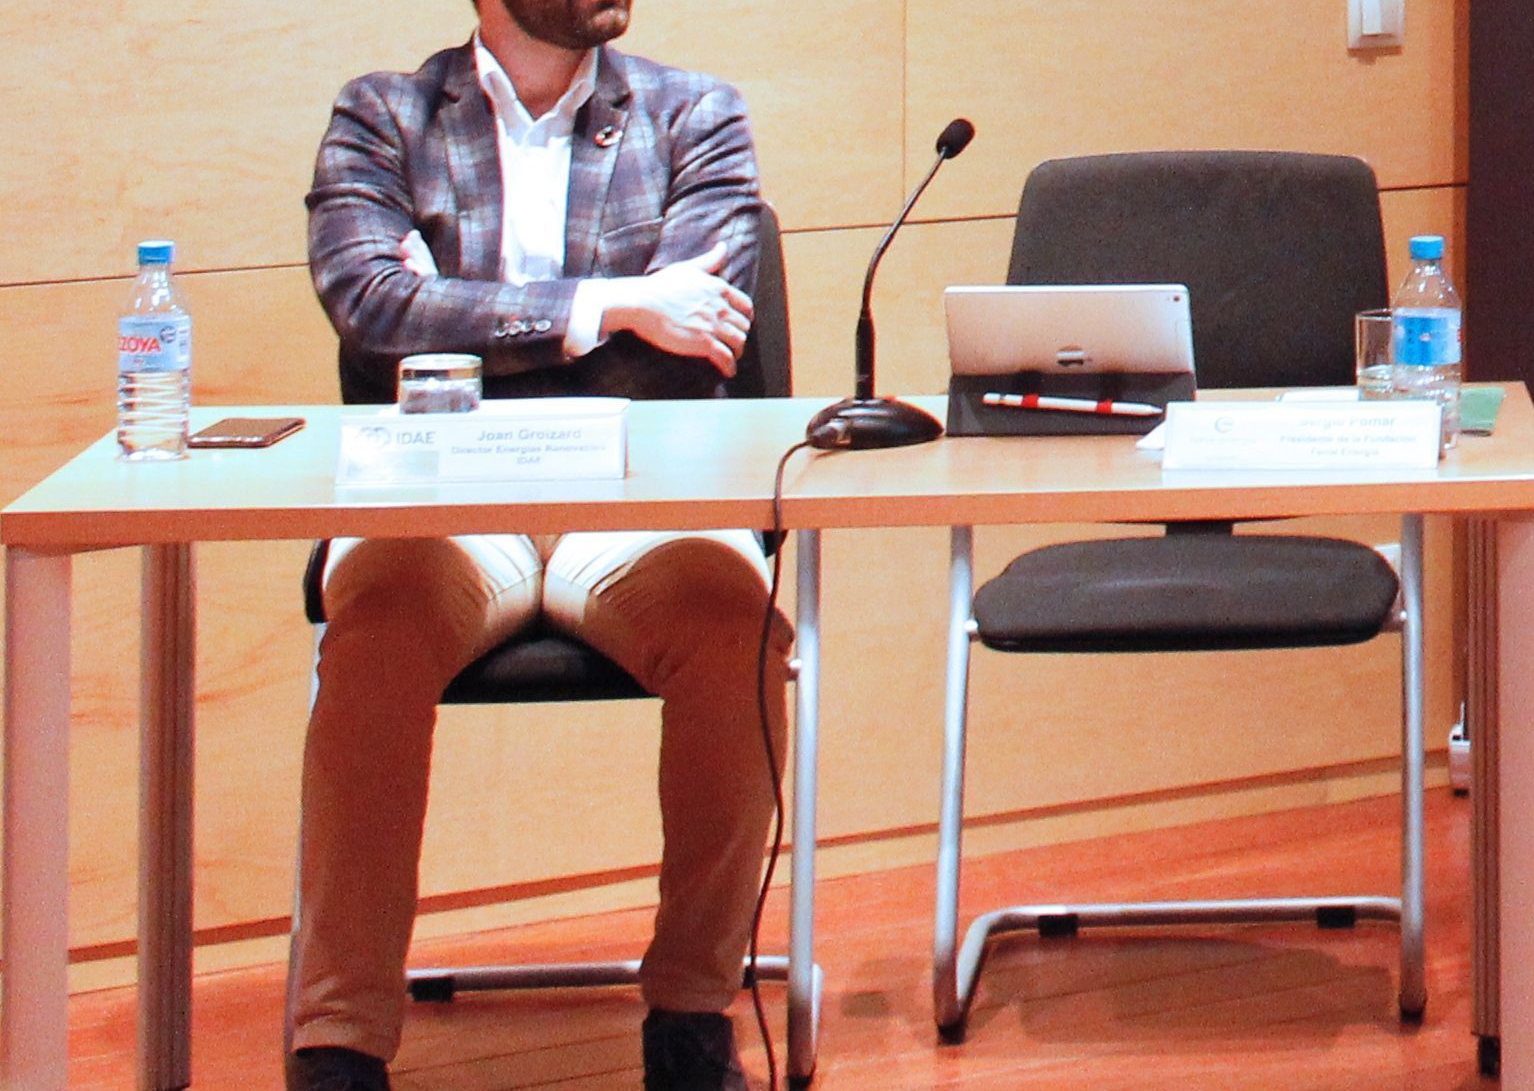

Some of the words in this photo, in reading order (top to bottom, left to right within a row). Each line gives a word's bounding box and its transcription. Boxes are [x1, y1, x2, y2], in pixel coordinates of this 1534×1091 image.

[395, 431, 436, 445] IDAE
[477, 429, 513, 441] Joan
[518, 428, 582, 441] Groizard
